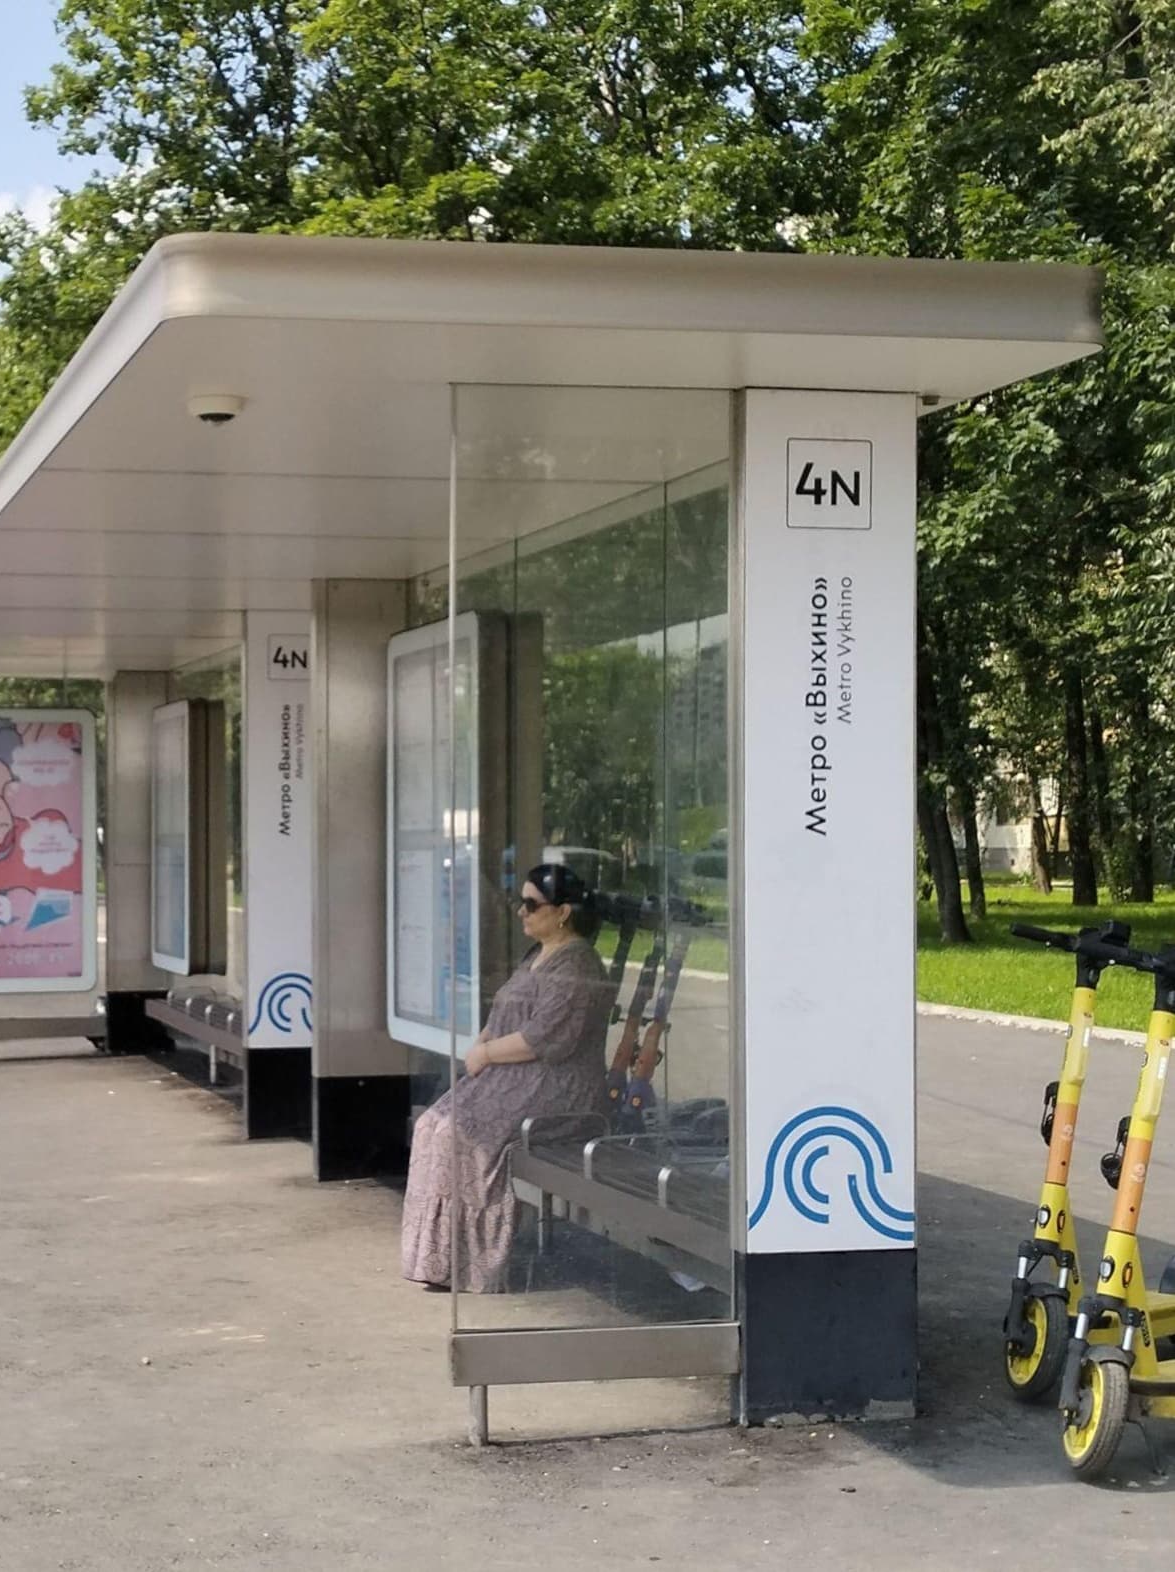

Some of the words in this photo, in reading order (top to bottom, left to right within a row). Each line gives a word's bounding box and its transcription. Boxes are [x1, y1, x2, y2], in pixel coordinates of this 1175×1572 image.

[795, 462, 861, 507] 4N
[836, 576, 856, 657] Vykhino
[272, 646, 308, 669] 4N
[804, 576, 828, 725] «Выхино»
[836, 662, 853, 724] Metro
[279, 783, 293, 836] Метро
[805, 735, 832, 837] Метро
